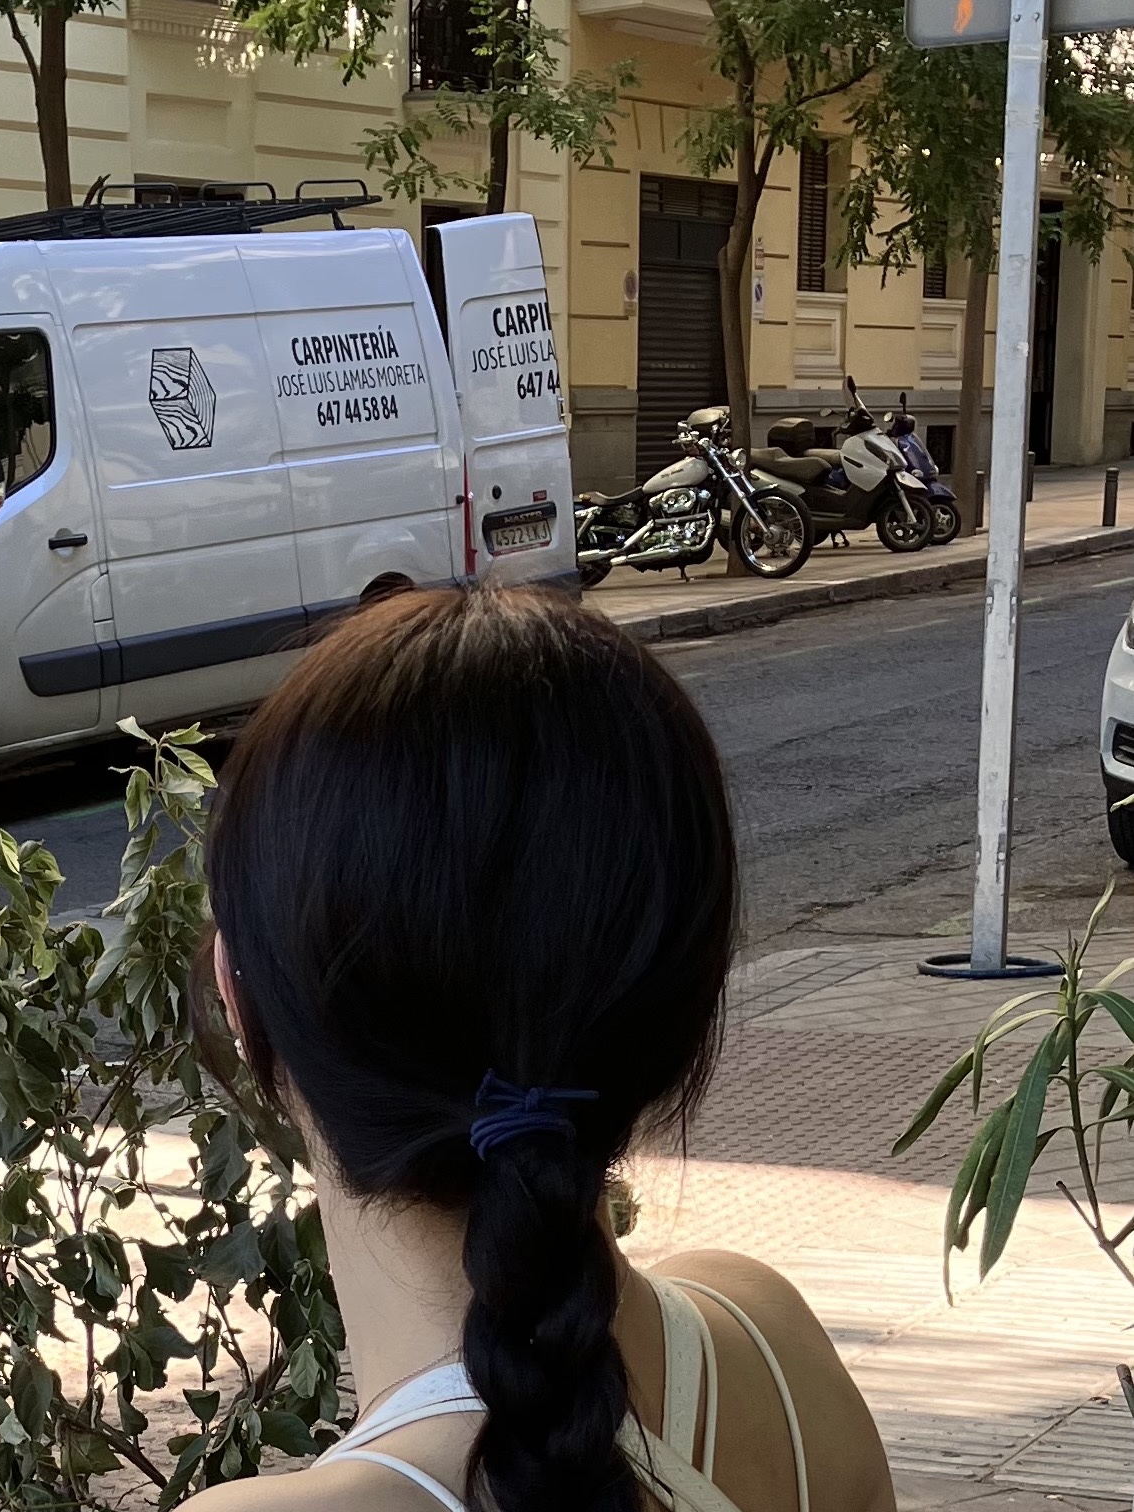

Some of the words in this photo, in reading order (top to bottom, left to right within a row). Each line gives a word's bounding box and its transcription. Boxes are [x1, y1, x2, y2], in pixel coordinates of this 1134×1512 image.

[291, 325, 399, 366] CARPINTERÍA
[472, 340, 507, 373] JOSÉ
[508, 340, 539, 366] LUIS
[277, 369, 307, 398] JOSÉ
[307, 370, 336, 395] LUIS
[335, 367, 376, 392] LAMAS
[376, 363, 426, 388] MORETA
[517, 371, 543, 400] 647
[317, 400, 340, 427] 647
[345, 398, 362, 423] 44
[362, 396, 380, 422] 58
[381, 394, 399, 420] 84
[495, 528, 526, 547] 4522
[526, 522, 548, 541] LKJ
